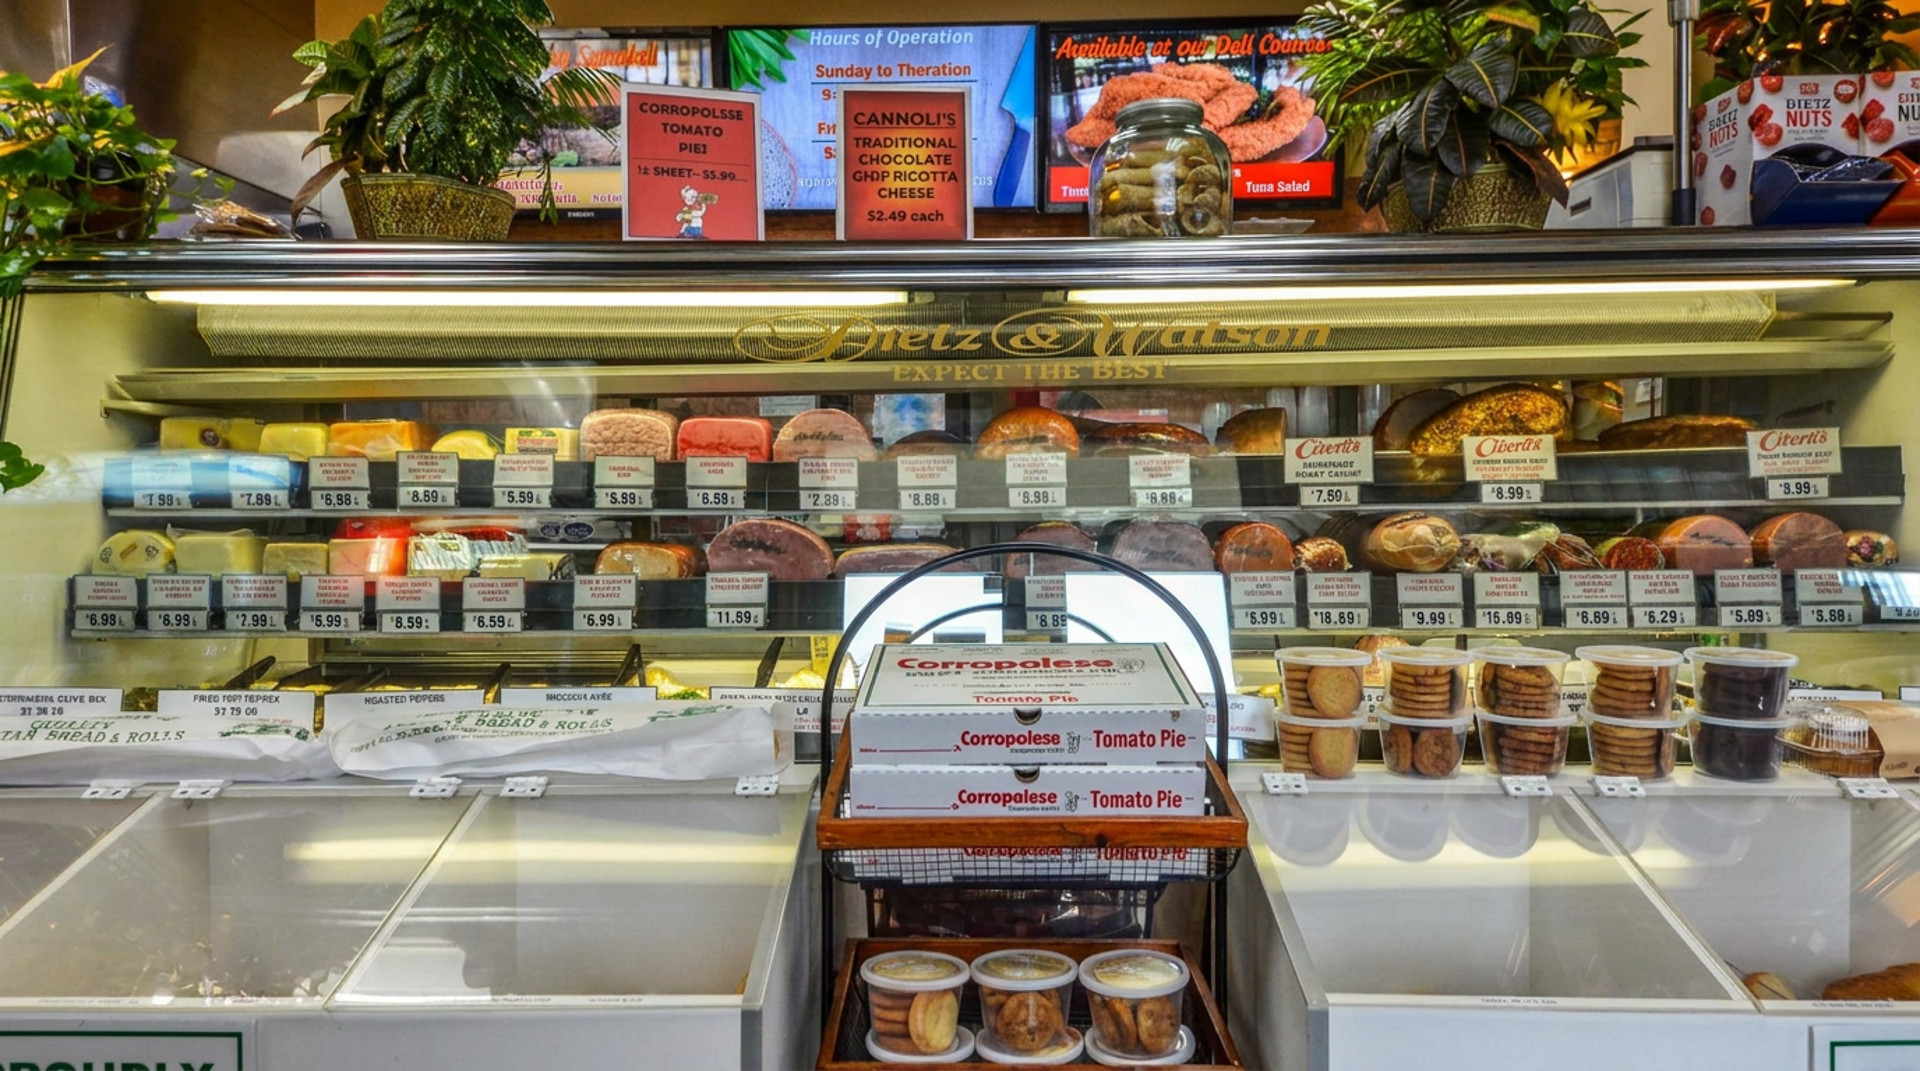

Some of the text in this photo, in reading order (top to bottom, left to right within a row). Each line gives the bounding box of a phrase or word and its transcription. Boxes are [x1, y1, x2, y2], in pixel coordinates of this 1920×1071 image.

[810, 29, 974, 48] Hours of Operation
[815, 63, 971, 80] Sunday to Theration
[853, 112, 956, 126] CANNOLI'S
[1786, 111, 1832, 128] NUTS
[661, 122, 723, 138] TOMATO
[853, 137, 957, 149] TRADITIONAL
[858, 154, 953, 165] CHOCOLATE
[893, 170, 958, 182] RICOTTA
[877, 187, 935, 199] CHEESE
[1246, 181, 1274, 193] Tuna
[892, 361, 1167, 382] EXPECT THE BEST
[960, 730, 1061, 749] Corropolese
[1093, 730, 1187, 749] Tomato Pie
[1090, 790, 1183, 809] Tomato Pie
